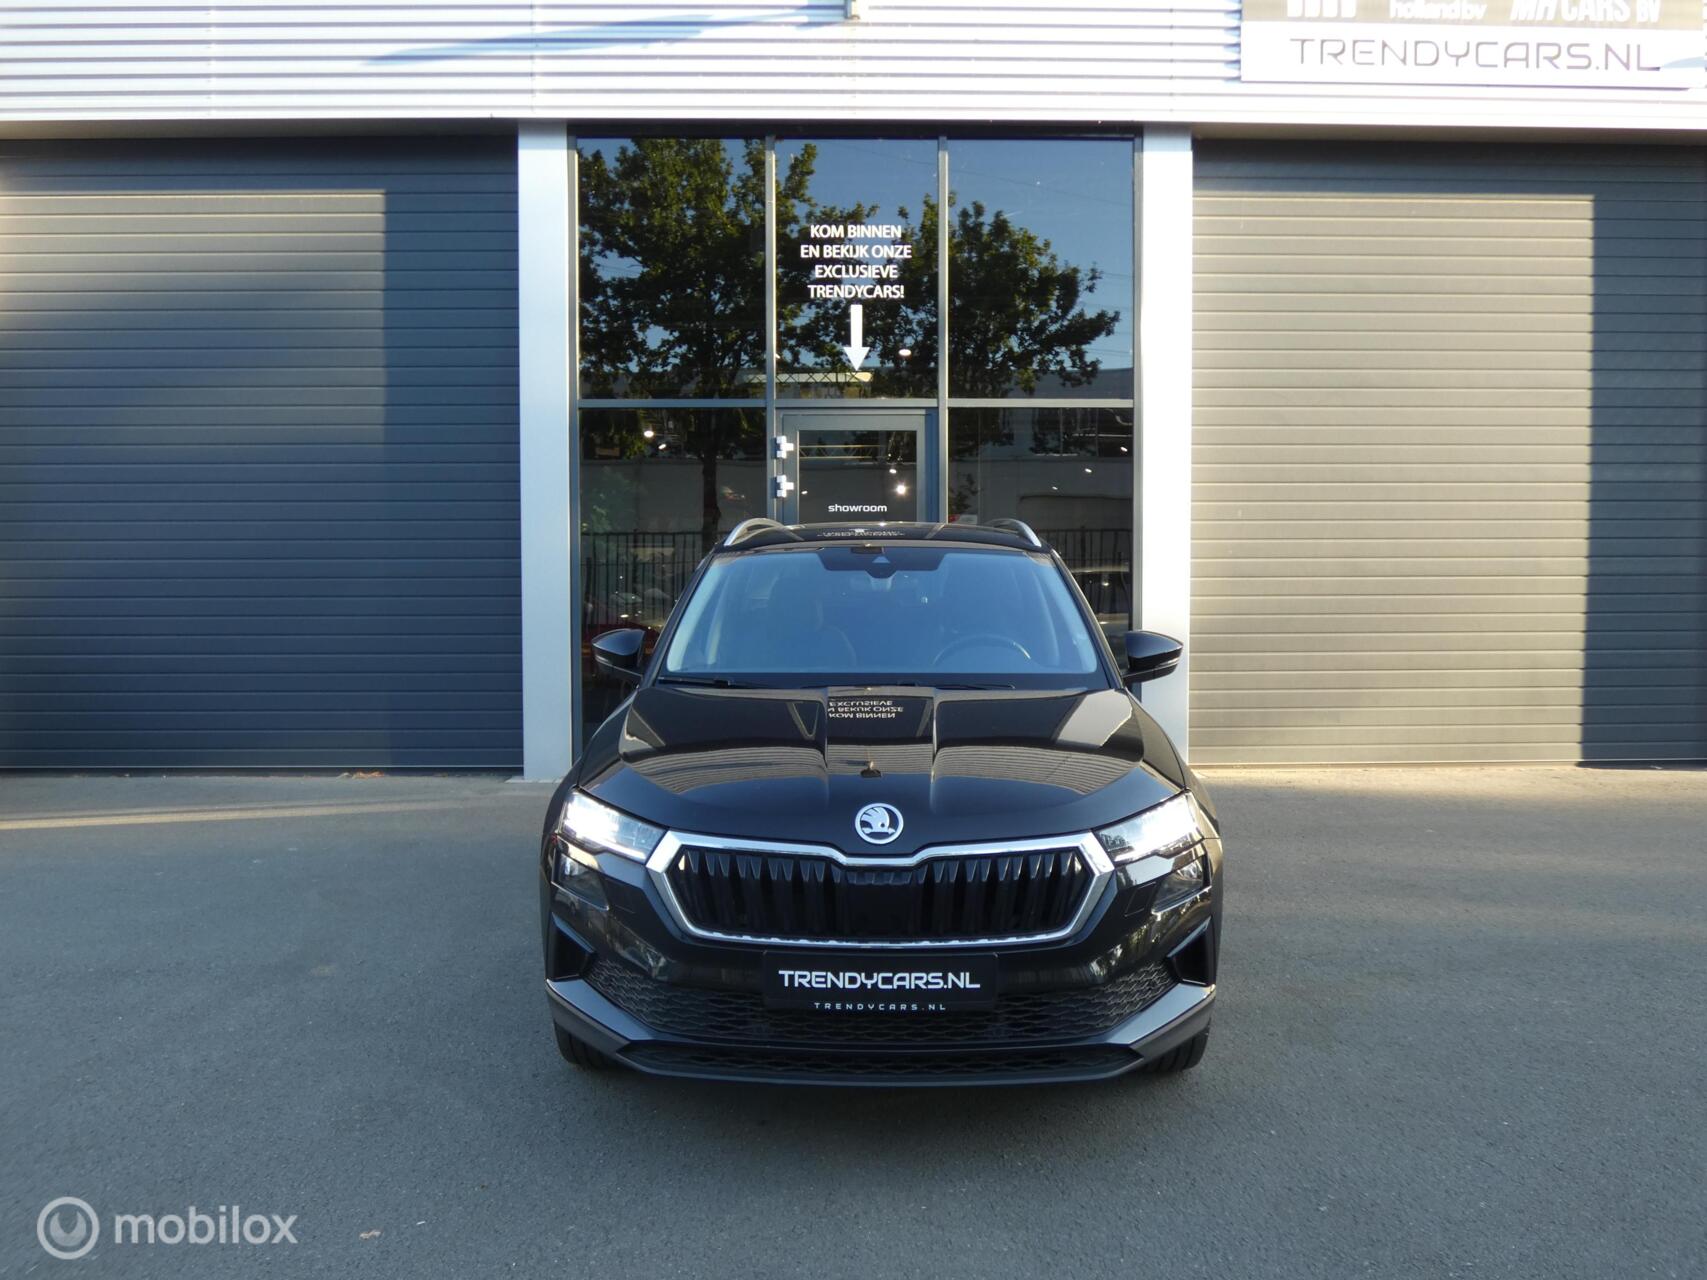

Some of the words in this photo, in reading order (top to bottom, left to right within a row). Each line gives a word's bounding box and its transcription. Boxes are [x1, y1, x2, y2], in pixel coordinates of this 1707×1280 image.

[1289, 37, 1662, 72] TRENDYCARS.NL
[810, 224, 845, 238] KOM
[847, 224, 901, 238] BINNEN
[800, 244, 820, 258] EN
[823, 244, 869, 258] BEKIJK
[871, 244, 912, 258] ONZE
[814, 264, 898, 278] EXCLUSIEVE
[807, 284, 905, 298] TRENDYCARS!
[828, 503, 888, 512] showroom
[778, 970, 981, 990] TRENDYCARS.NL
[814, 1002, 947, 1011] TRENDYCARS.NL
